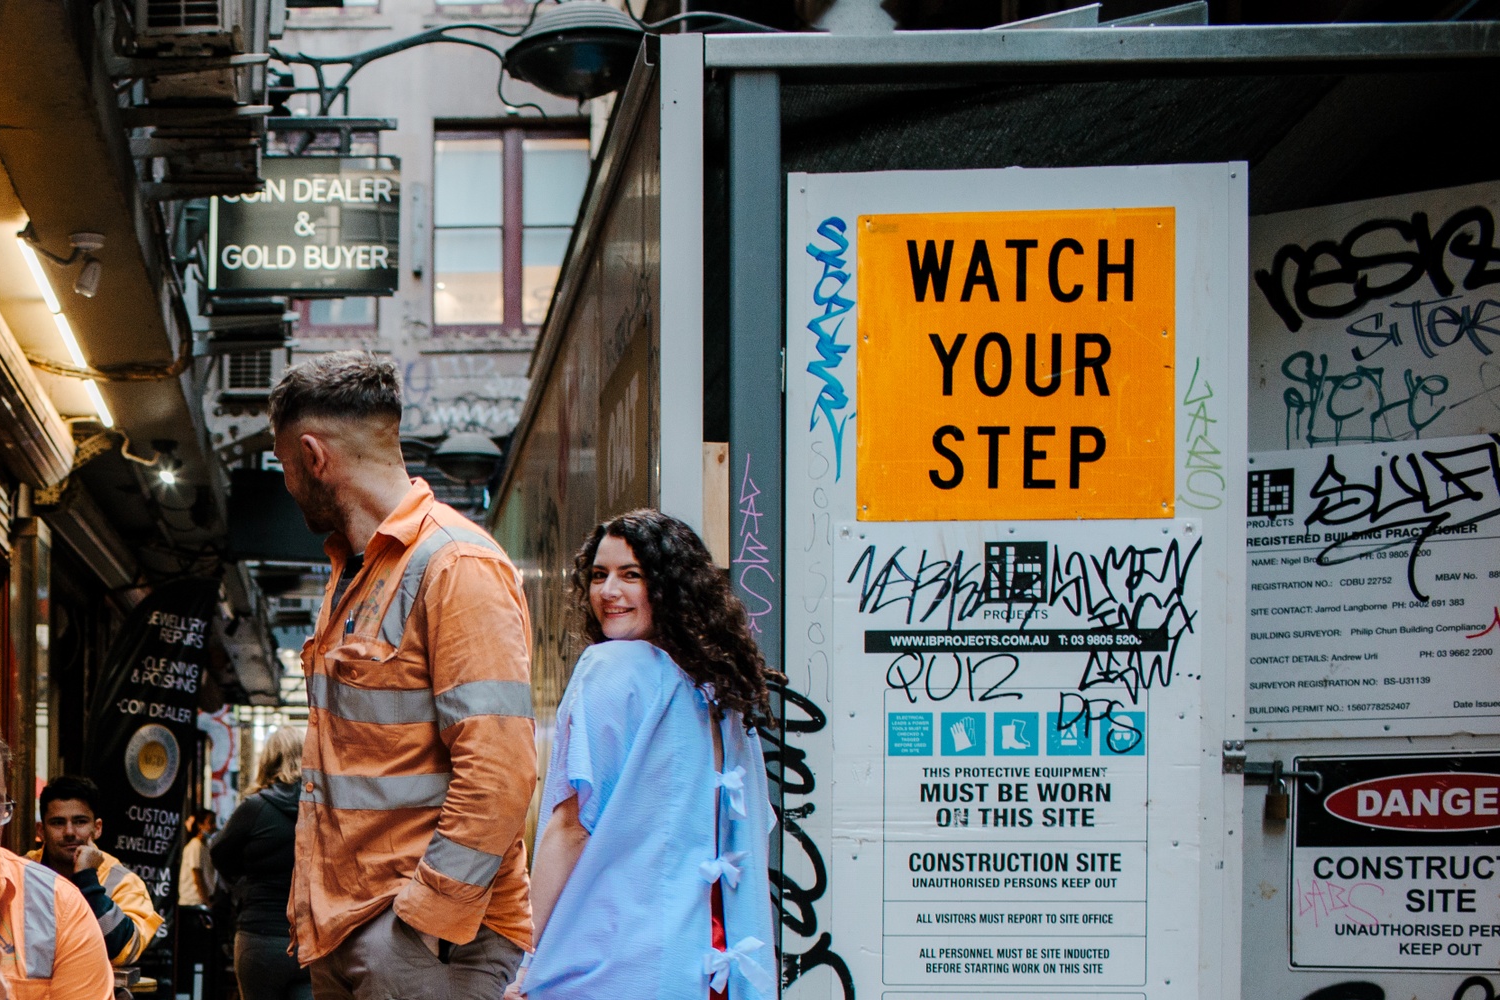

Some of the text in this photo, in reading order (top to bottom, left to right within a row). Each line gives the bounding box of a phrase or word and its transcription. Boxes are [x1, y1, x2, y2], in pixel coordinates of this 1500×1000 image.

[293, 178, 392, 203] DEALER
[294, 211, 316, 237] &
[221, 245, 389, 270] GOLD BUYER
[907, 238, 1134, 303] WATCH
[928, 331, 1112, 397] YOUR
[928, 425, 1107, 490] STEP
[1246, 518, 1294, 529] PROJECTS
[1246, 534, 1321, 547] REGISTERED
[1251, 557, 1278, 567] NAME:
[1281, 556, 1301, 567] Nigel
[1376, 551, 1387, 560] 03
[1388, 550, 1409, 559] 9805
[1251, 580, 1313, 591] REGISTRATION
[1340, 578, 1365, 587] CDBU
[1367, 577, 1392, 586] 22752
[1435, 572, 1461, 581] MBAV
[1463, 572, 1478, 580] No.
[983, 610, 1049, 620] PROJECTS
[1250, 598, 1465, 617] SITE CONTACT: Jarrod Langborne PH: 0402 691 383
[1250, 622, 1487, 640] BUILDING SURVEYOR: Philip Chun Building Compliance
[890, 635, 1050, 647] WWW.IBPROJECTS.COM.AU
[1058, 635, 1068, 645] T:
[1070, 635, 1085, 645] 03
[1086, 635, 1114, 645] 9805
[1249, 656, 1290, 665] CONTACT
[1292, 654, 1329, 663] DETAILS:
[1331, 652, 1362, 662] Andrew
[1419, 650, 1435, 658] PH:
[1449, 649, 1470, 657] 9662
[1472, 648, 1493, 656] 2200
[1249, 676, 1431, 690] SURVEYOR REGISTRATION NO: BS-U31139
[1249, 705, 1290, 715] BUILDING
[1291, 704, 1324, 713] PERMIT
[1453, 700, 1473, 709] Date
[922, 767, 1108, 779] THIS PROTECTIVE EQUIPMENT
[920, 783, 1112, 803] MUST BE WORN
[1356, 787, 1499, 817] DANGE
[978, 808, 1033, 828] THIS
[1042, 808, 1095, 828] SITE
[908, 853, 1122, 872] CONSTRUCTION SITE
[912, 878, 1117, 888] UNAUTHORISED PERSONS KEEP OUT
[1405, 889, 1477, 913] SITE
[916, 914, 1114, 924] ALL VISITORS MUST REPORT TO SITE OFFICE
[1334, 924, 1464, 938] UNAUTHORISED
[919, 948, 1110, 959] ALL PERSONNEL MUST BE SITE INDUCTED
[1399, 943, 1483, 956] KEEP OUT
[925, 963, 1104, 974] BEFORE STARTING WORK ON THIS SITE
